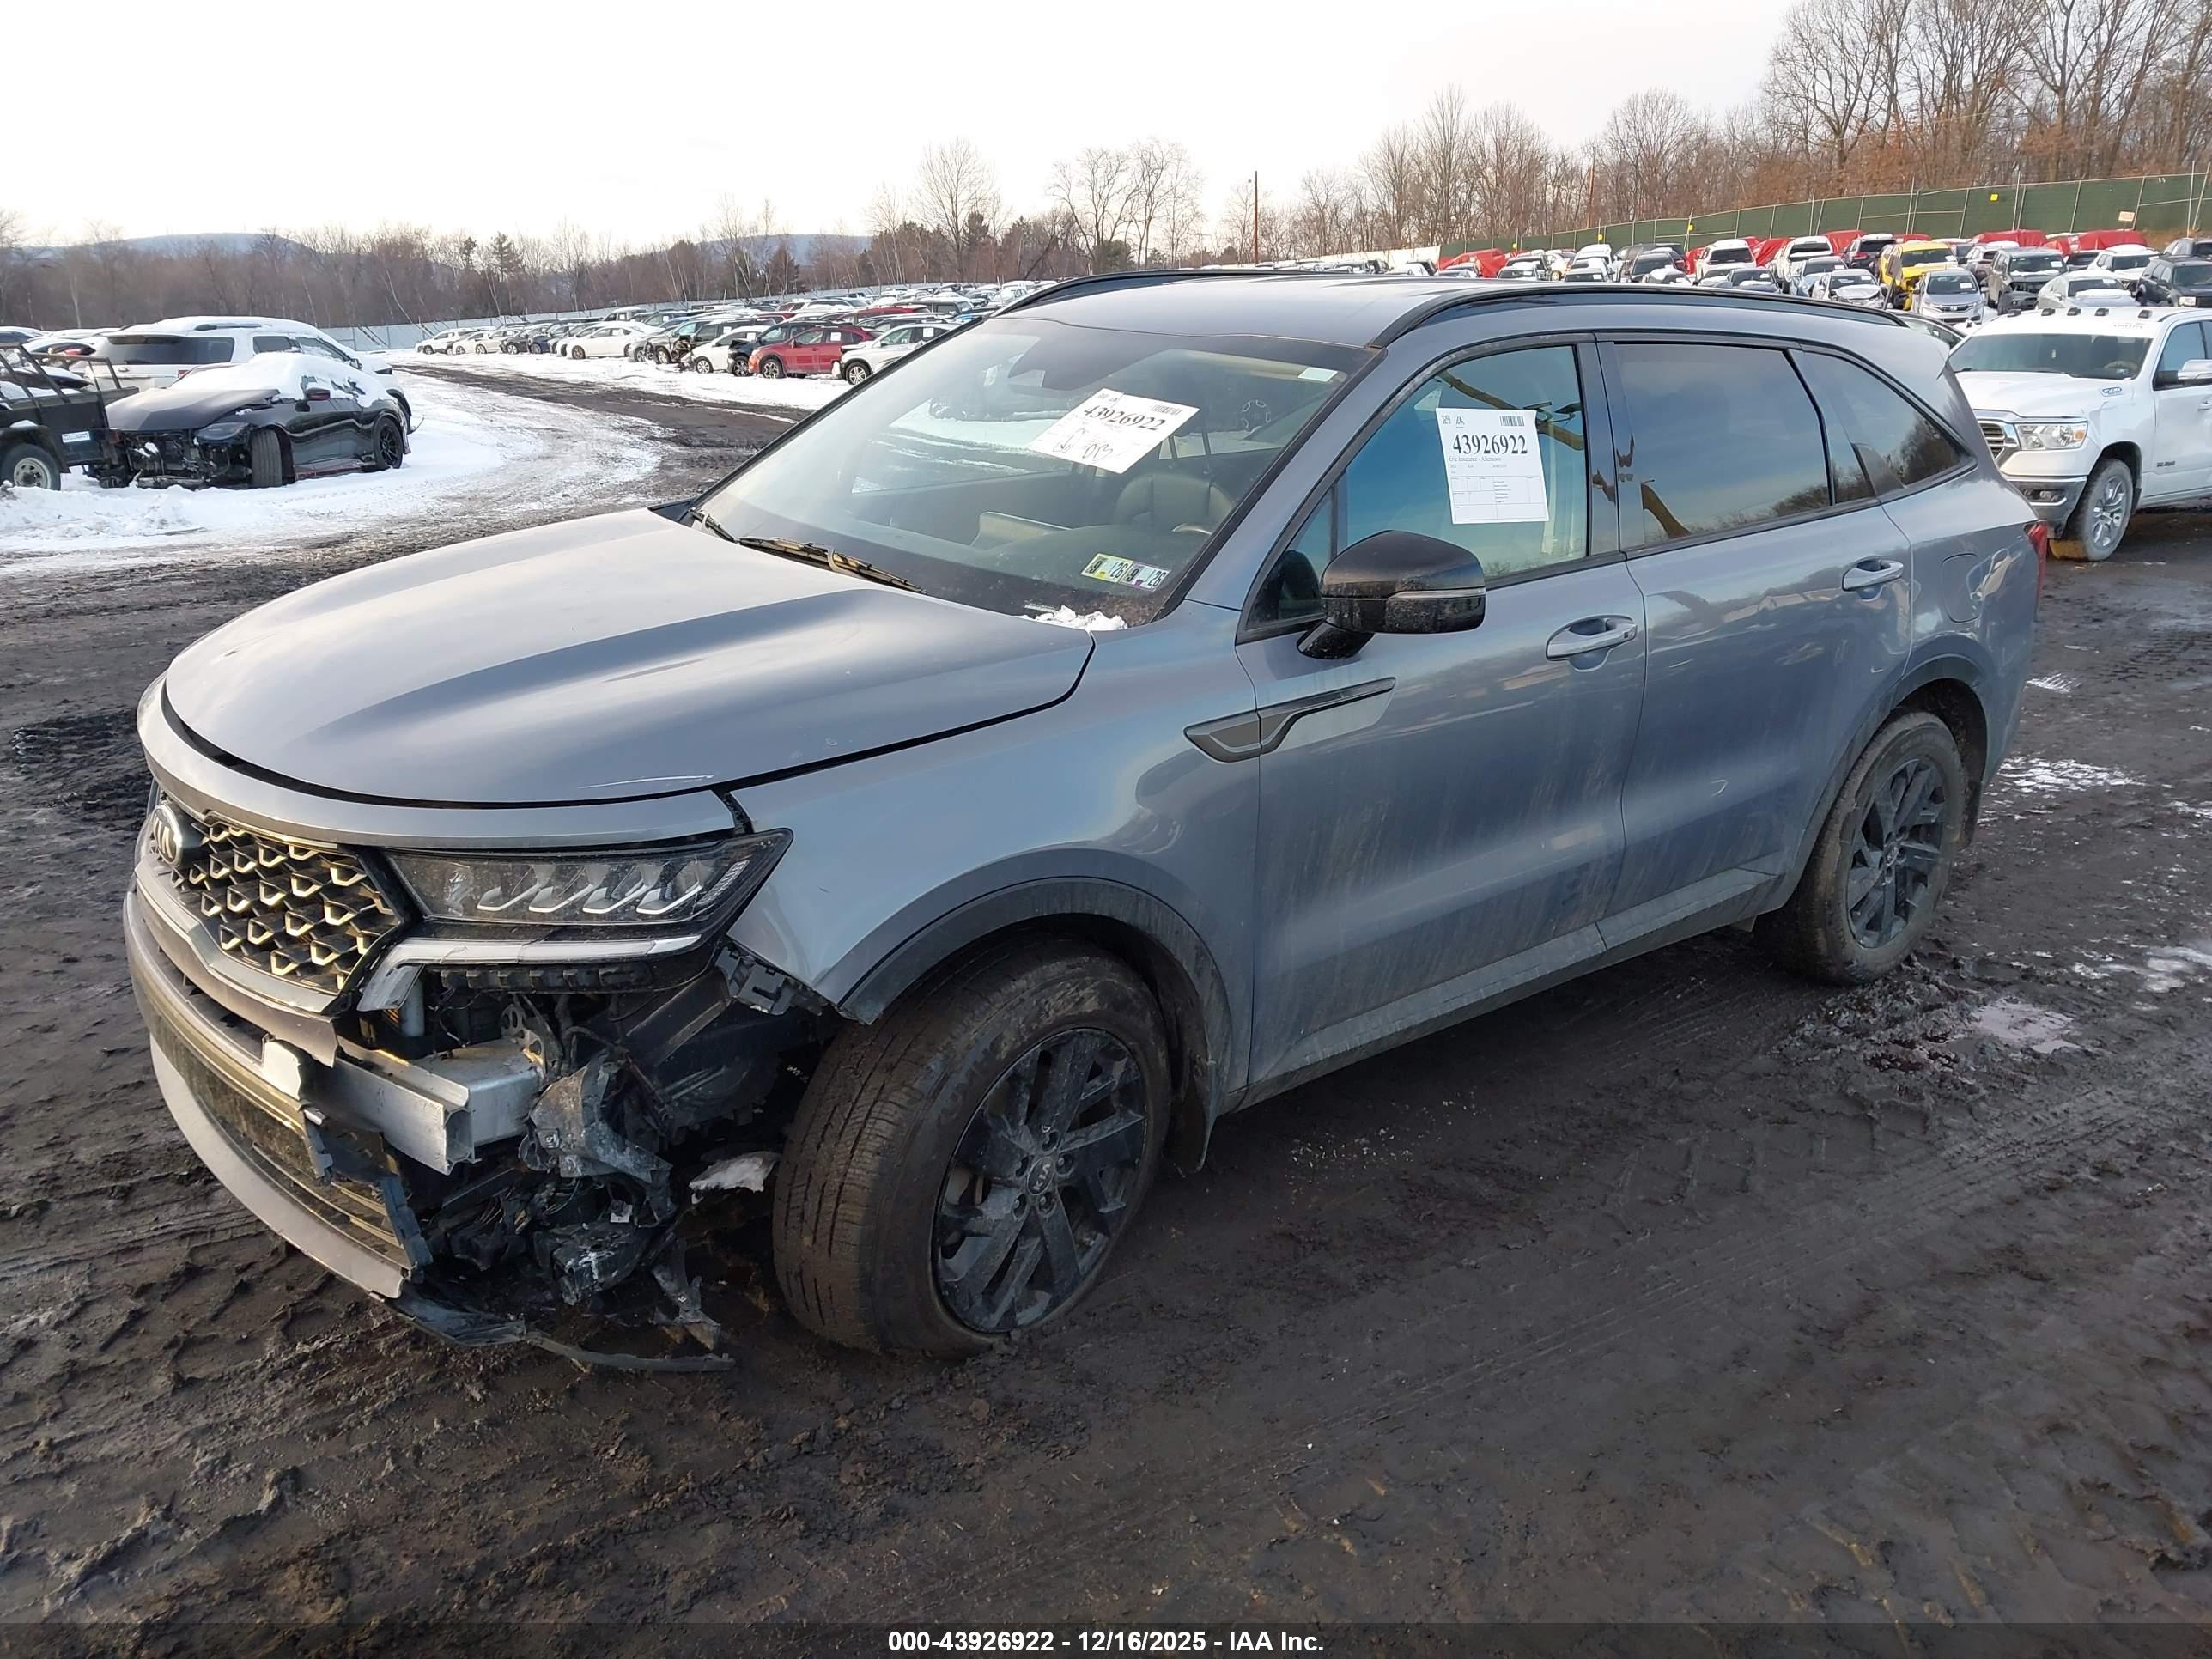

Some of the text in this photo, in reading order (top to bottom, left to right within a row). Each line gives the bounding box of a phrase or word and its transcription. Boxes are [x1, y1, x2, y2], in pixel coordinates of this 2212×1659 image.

[1085, 405, 1165, 430] 43926922
[1453, 434, 1528, 454] 43926922
[1032, 1163, 1051, 1190] KIA
